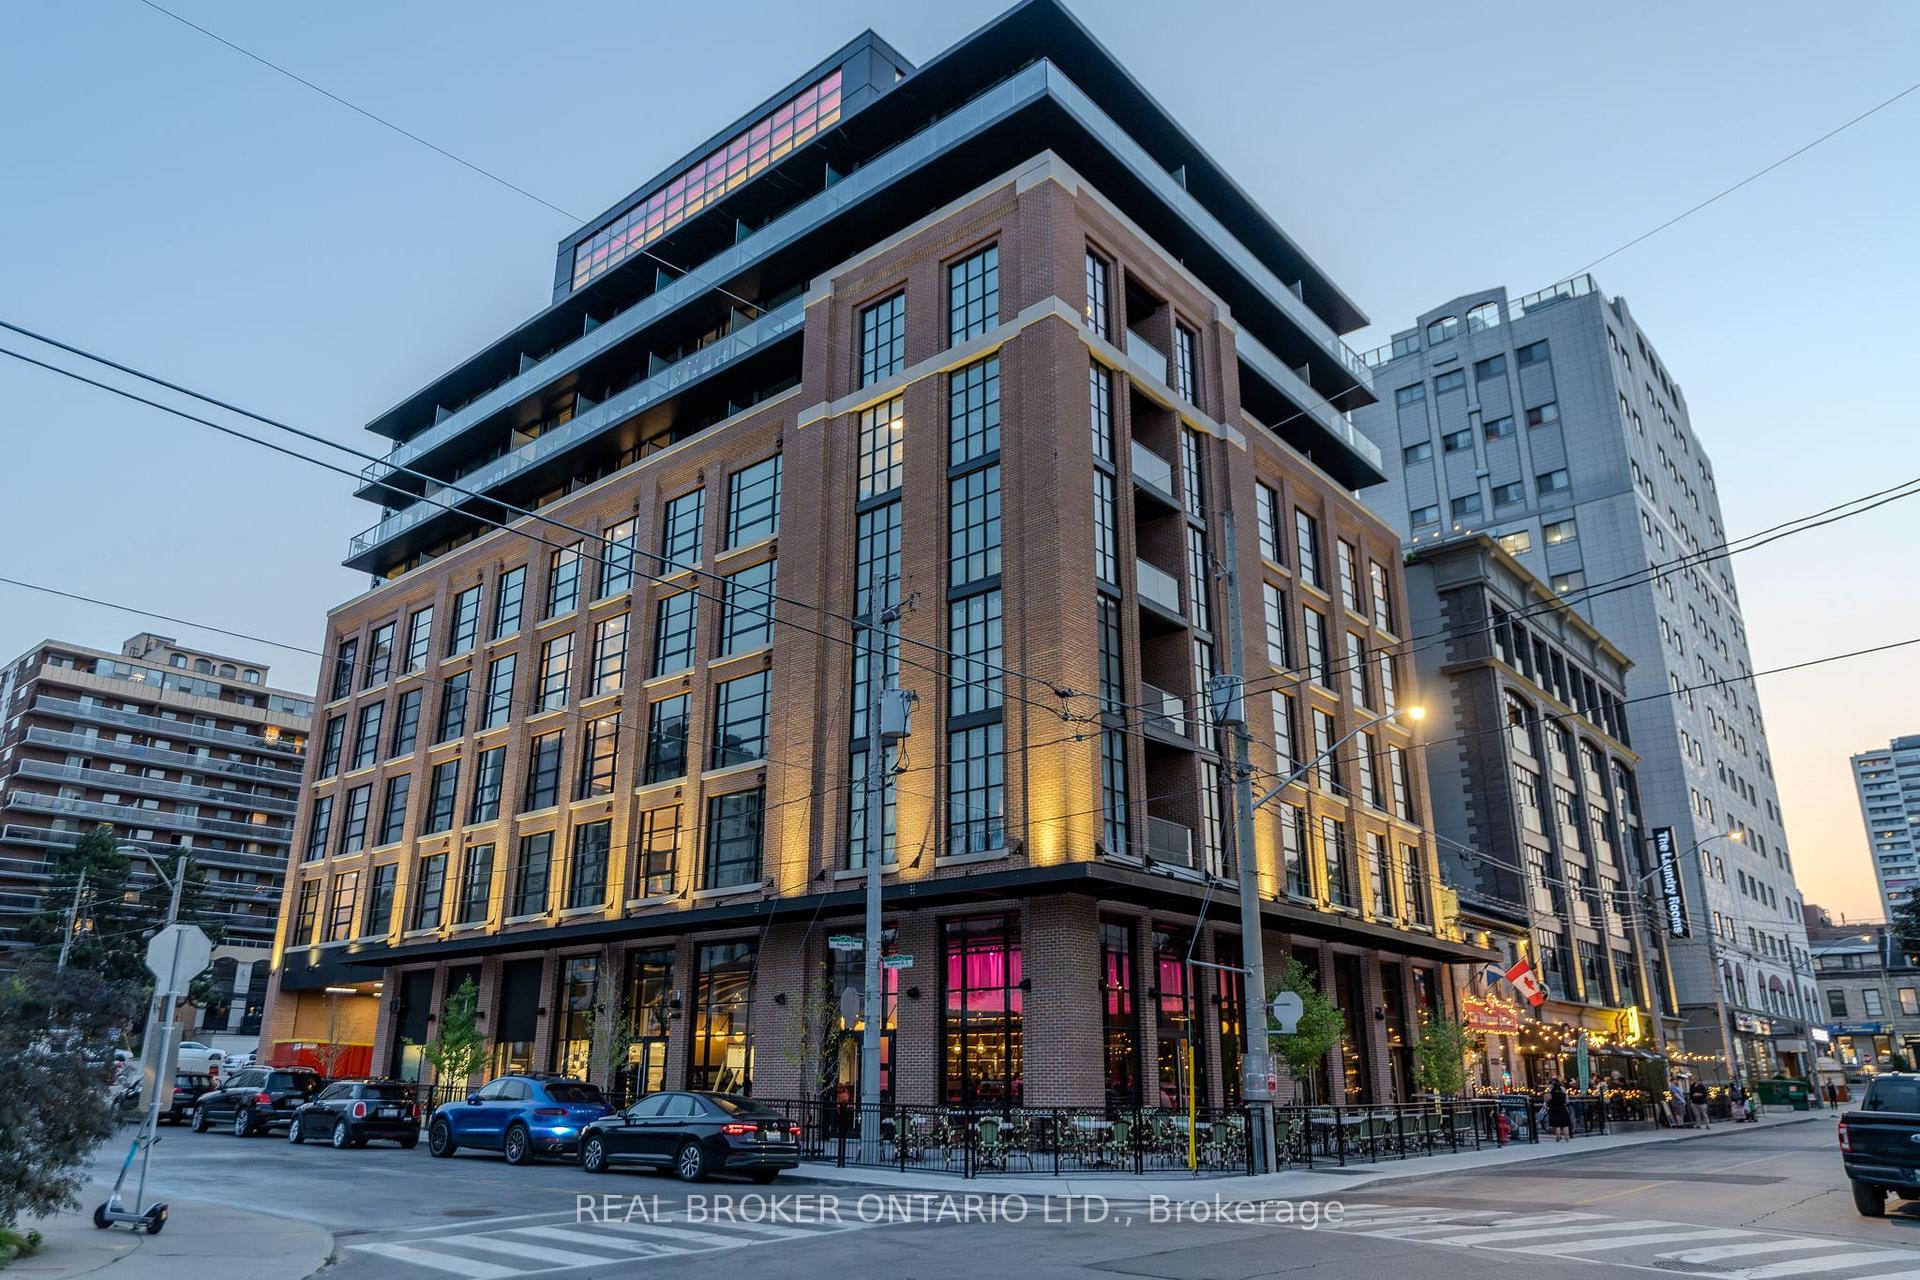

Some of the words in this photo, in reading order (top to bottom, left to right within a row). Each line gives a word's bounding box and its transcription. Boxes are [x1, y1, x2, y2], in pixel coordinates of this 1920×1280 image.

[1657, 831, 1669, 851] The
[1660, 852, 1677, 895] Laundry
[1669, 896, 1683, 933] Rooms
